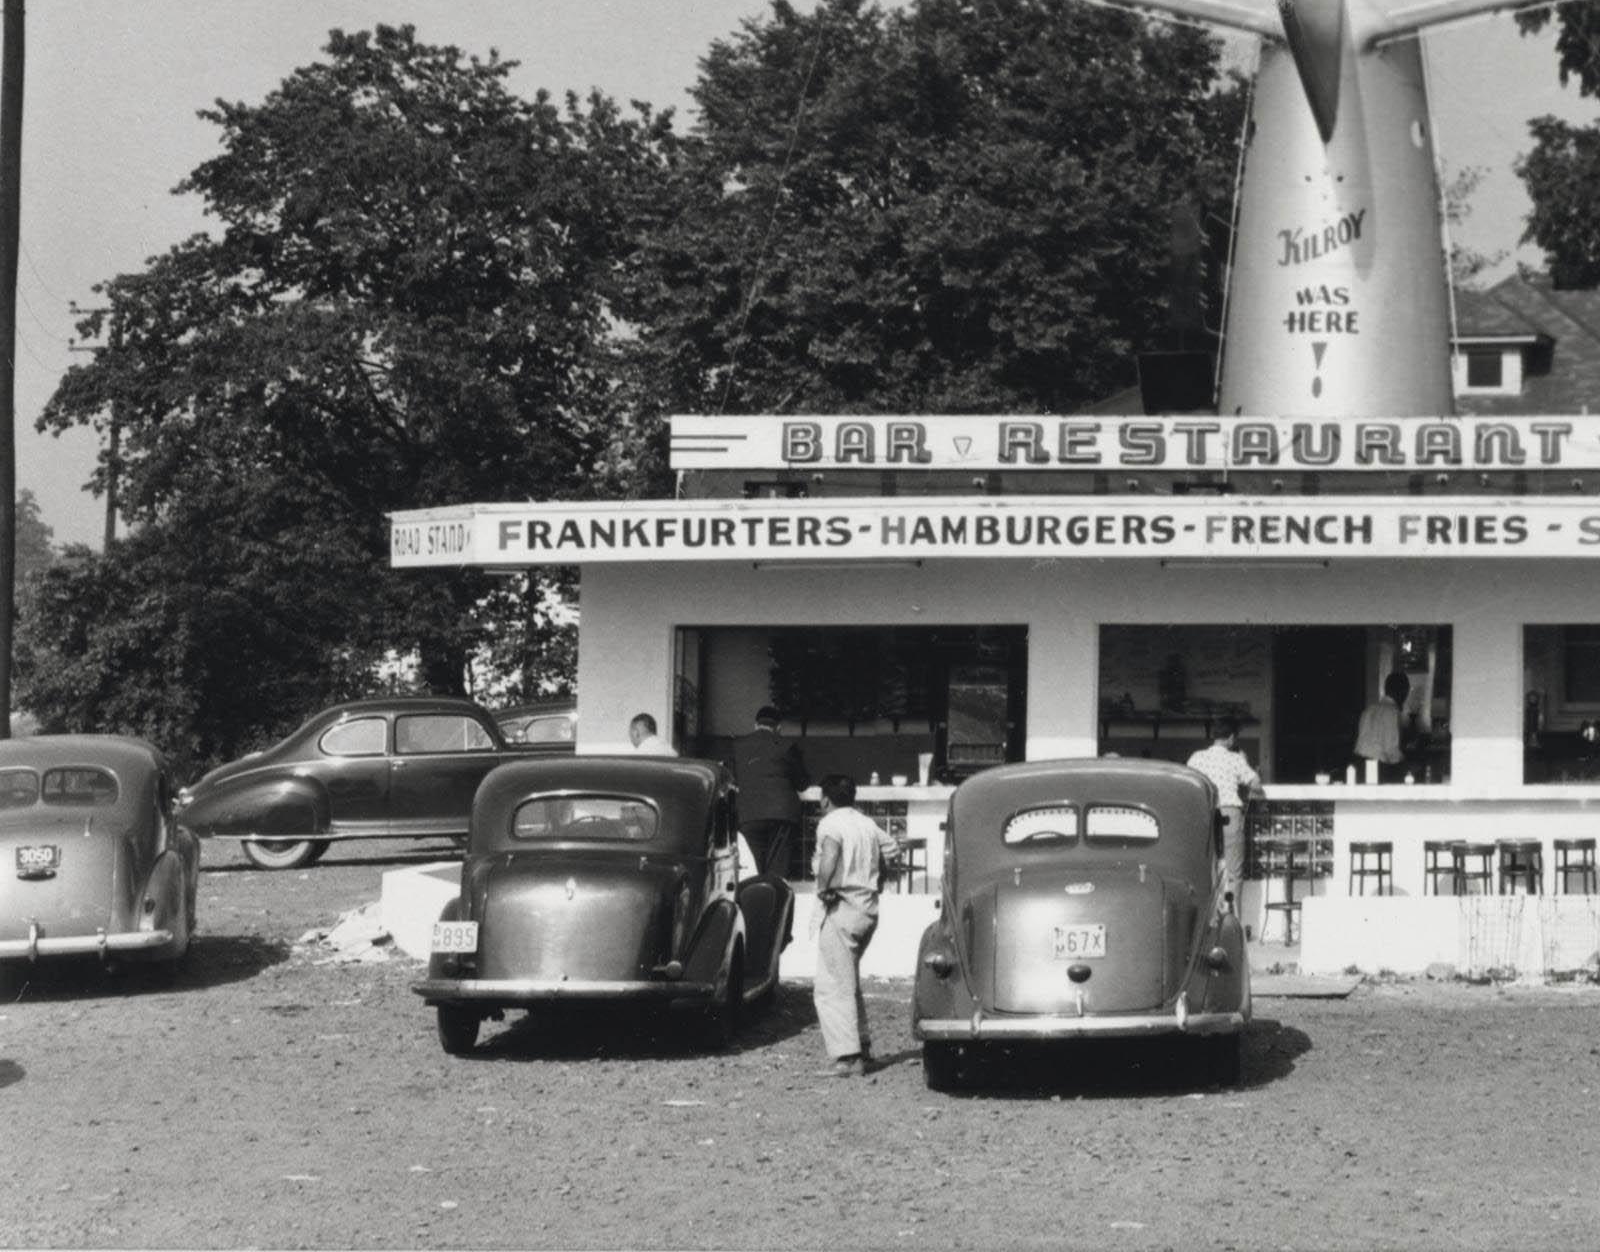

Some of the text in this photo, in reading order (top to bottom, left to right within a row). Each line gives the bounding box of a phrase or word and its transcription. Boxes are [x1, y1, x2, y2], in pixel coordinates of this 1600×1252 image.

[1277, 208, 1366, 267] KILROY
[1296, 285, 1350, 306] WAS
[1283, 311, 1360, 334] HERE
[781, 421, 932, 465] BAR
[998, 421, 1572, 466] RESTAURANT
[1399, 514, 1528, 546] FRIES
